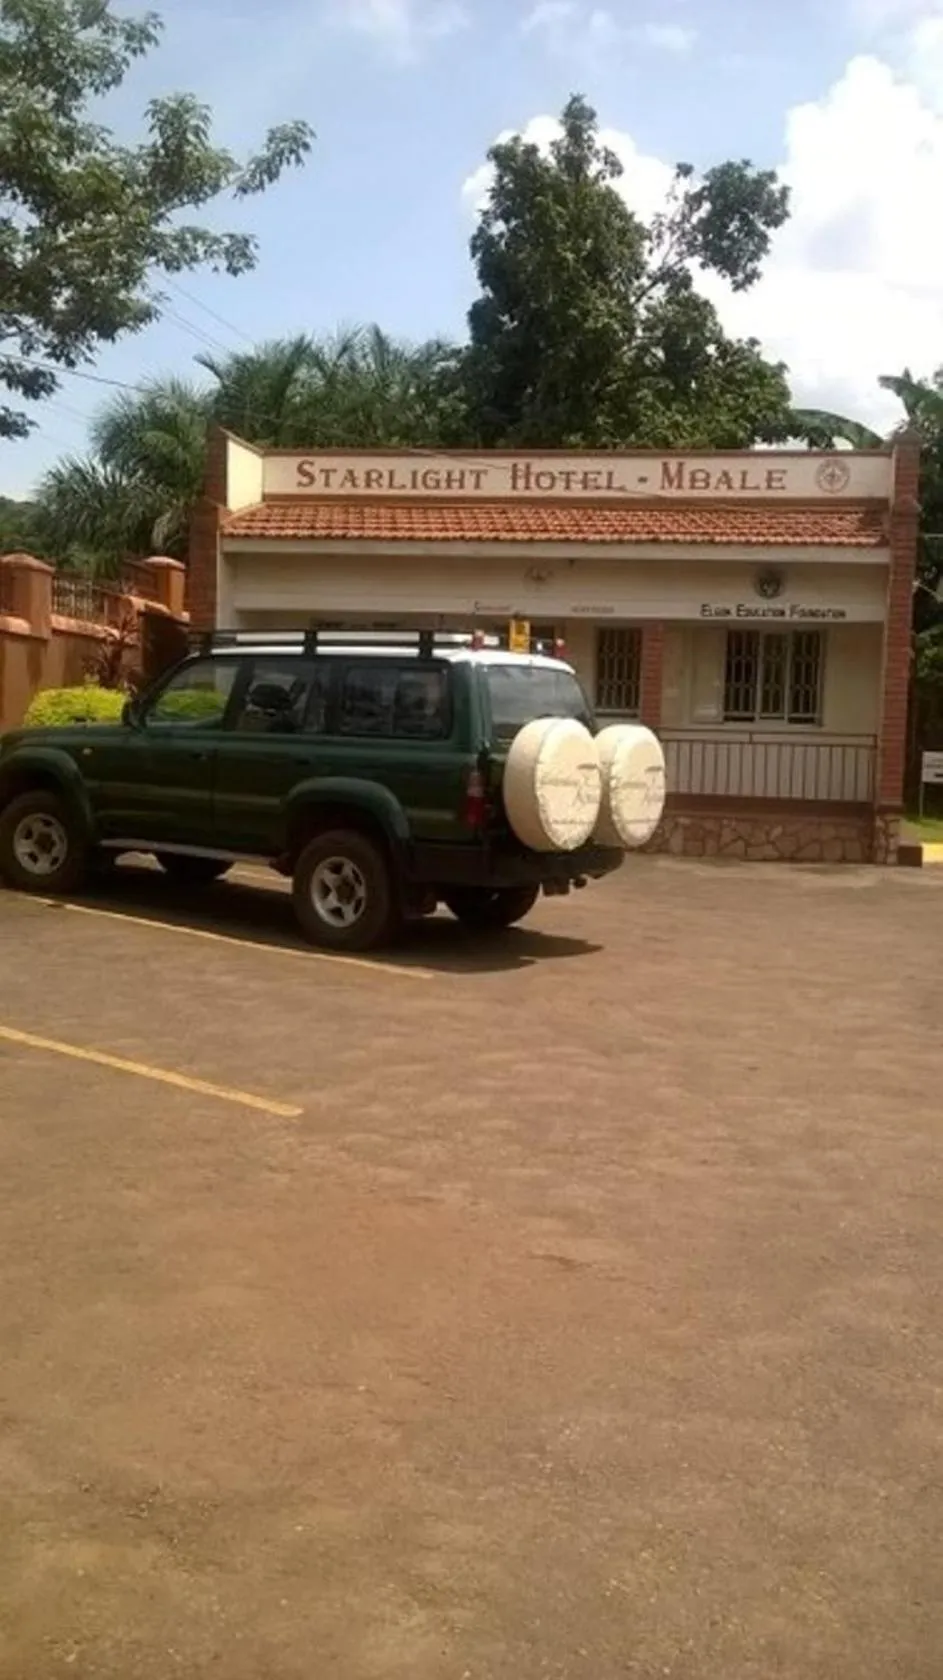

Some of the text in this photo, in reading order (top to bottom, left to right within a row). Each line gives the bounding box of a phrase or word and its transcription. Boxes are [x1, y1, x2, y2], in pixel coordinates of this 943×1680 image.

[296, 459, 488, 490] STARLIGHT
[510, 462, 625, 491] HOTEL
[660, 461, 788, 491] MBALE
[736, 603, 786, 618] EDUCATION
[789, 604, 847, 619] FOUNDATION
